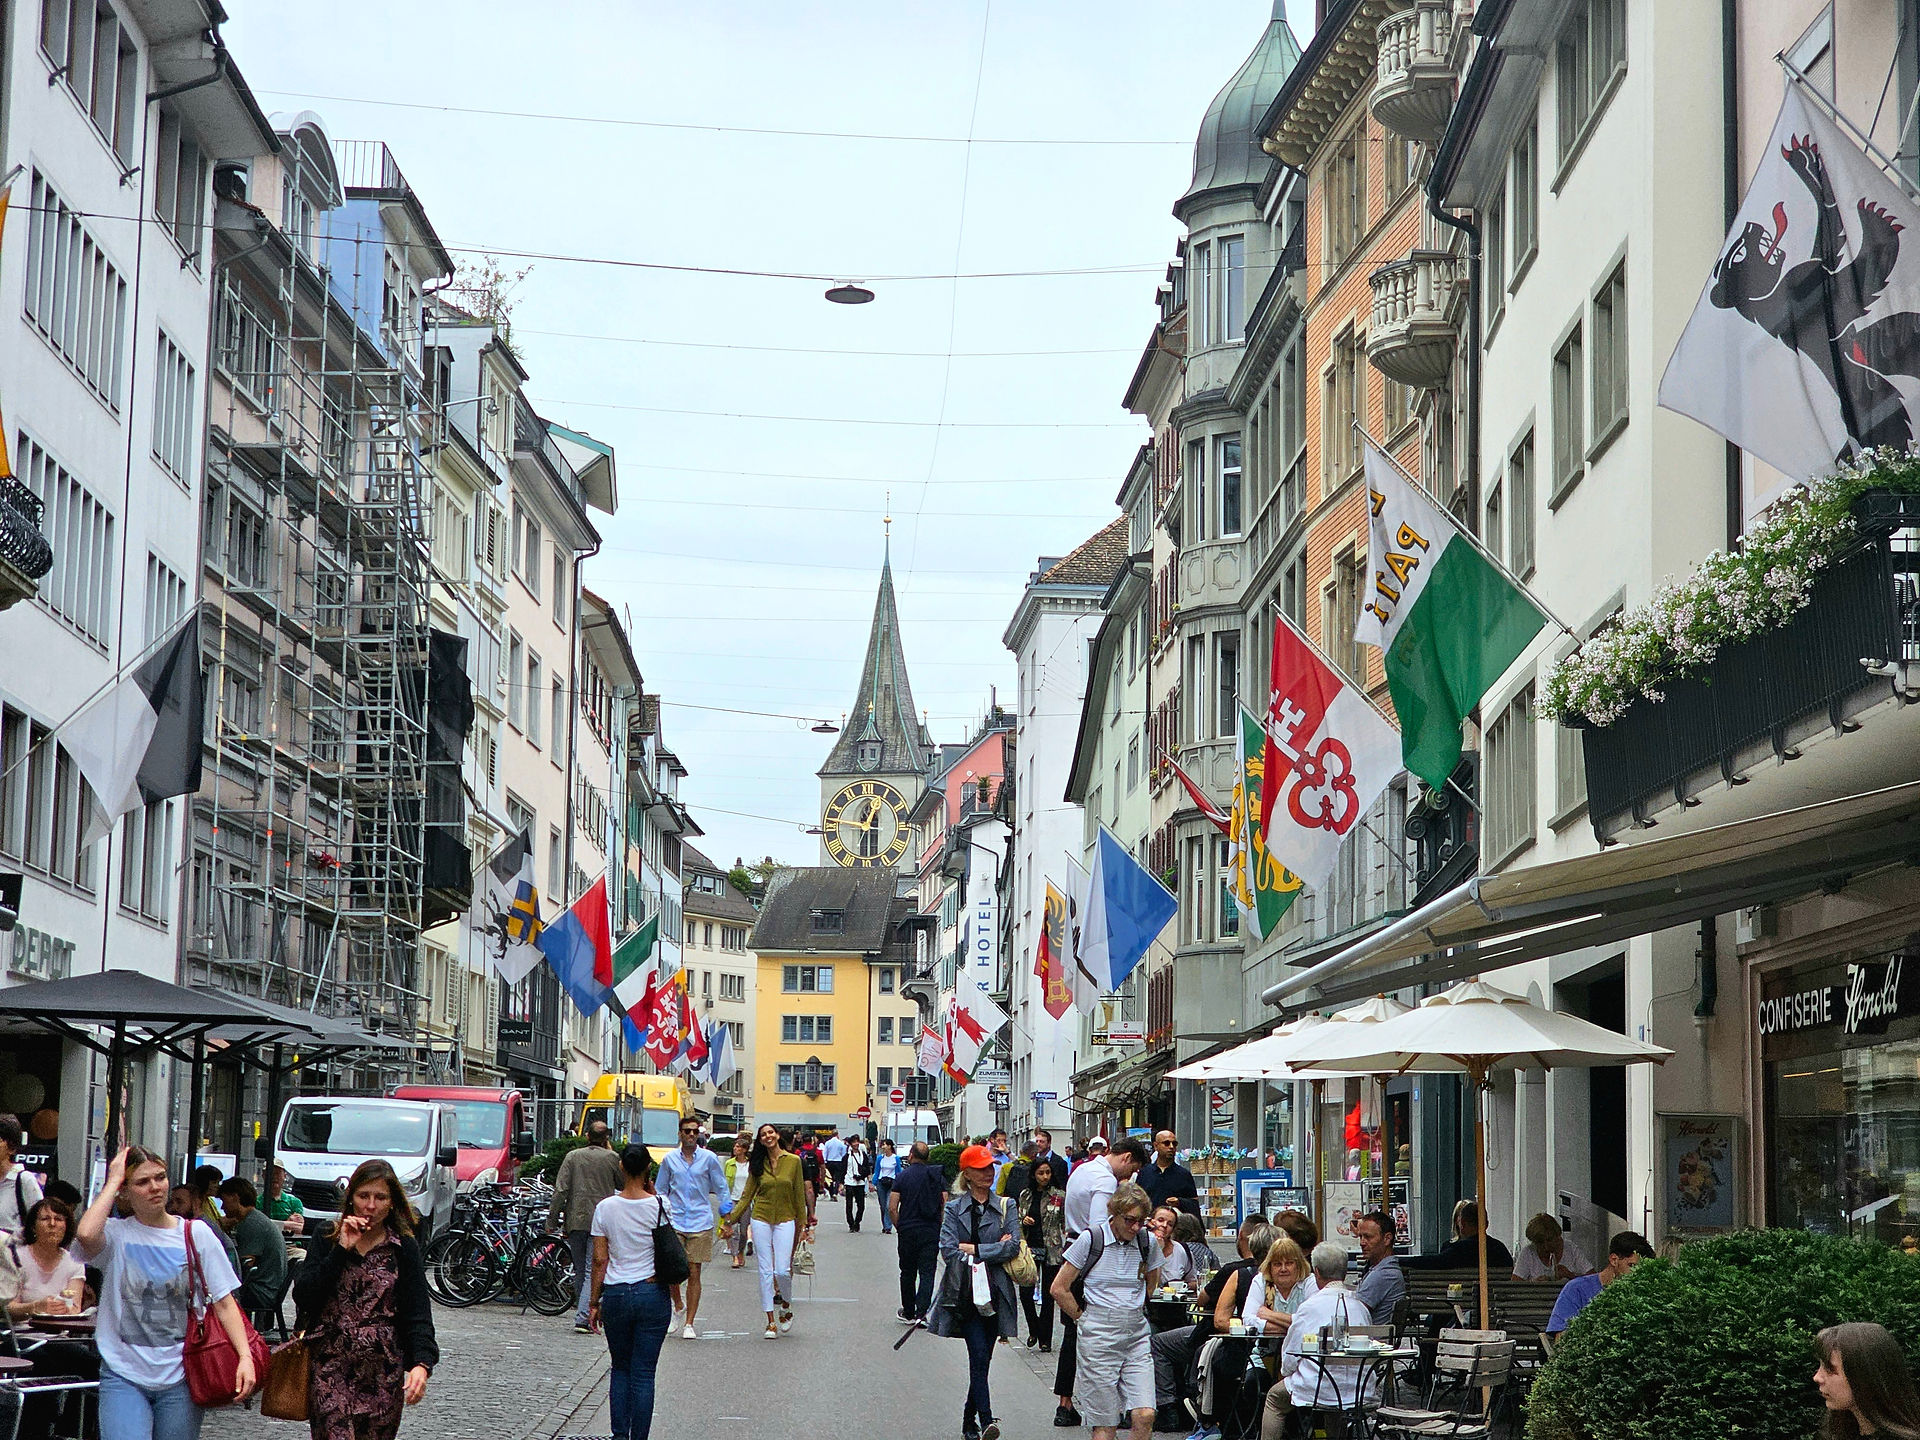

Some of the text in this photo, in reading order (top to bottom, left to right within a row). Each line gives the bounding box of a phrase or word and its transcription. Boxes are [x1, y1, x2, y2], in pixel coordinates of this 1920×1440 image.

[844, 788, 856, 800] XI
[861, 783, 874, 795] XII
[831, 804, 842, 813] X
[977, 897, 991, 967] HOTEL
[12, 921, 76, 979] DEPOT
[1757, 954, 1904, 1035] CONFISERIE Honold
